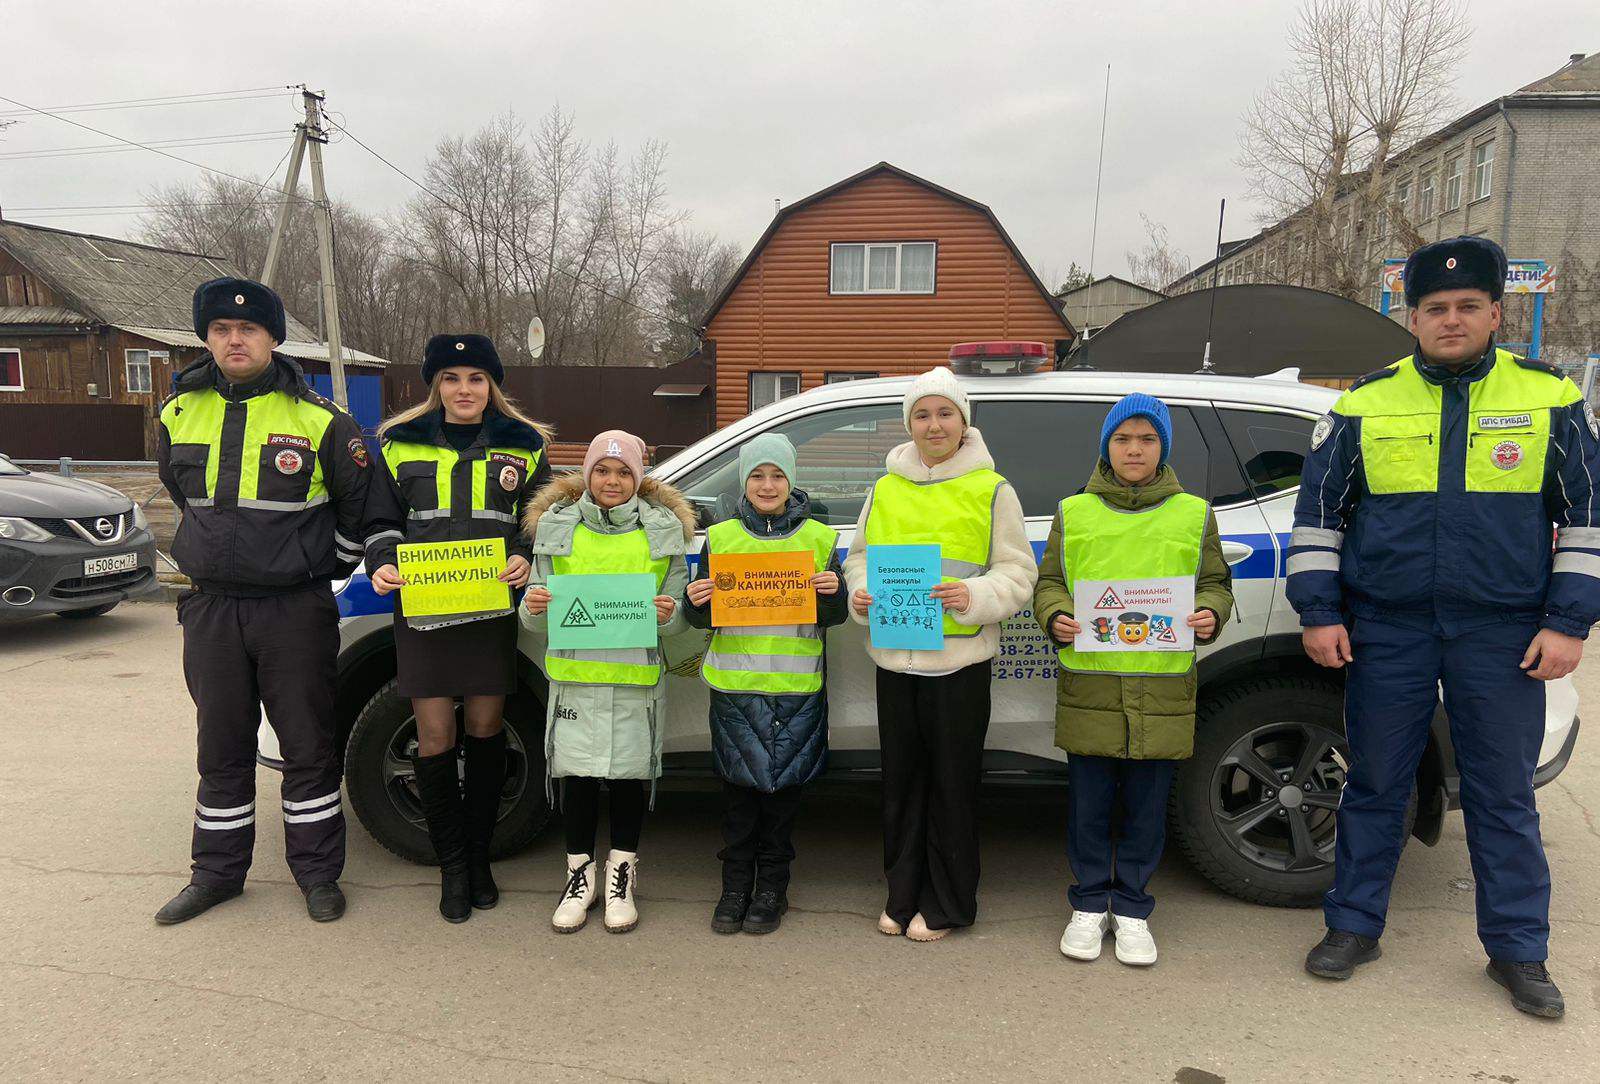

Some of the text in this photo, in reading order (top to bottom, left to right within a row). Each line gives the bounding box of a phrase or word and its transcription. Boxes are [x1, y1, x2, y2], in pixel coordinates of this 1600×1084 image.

[1481, 415, 1529, 426] ДПС ГИБДД
[605, 439, 622, 457] LA
[399, 544, 494, 563] ВНИМАНИЕ
[744, 570, 804, 579] ВНИМАНИЕ-
[878, 566, 926, 574] Безопасные
[401, 566, 499, 586] КАНИКУЛЫ!
[737, 579, 811, 591] КАНИКУЛЫ!
[1124, 587, 1172, 596] ВНИМАНИЕ,
[594, 600, 647, 609] ВНИМАНИЕ,
[1124, 597, 1172, 605] КАНИКУЛЫ!
[594, 612, 647, 621] КАНИКУЛЫ!
